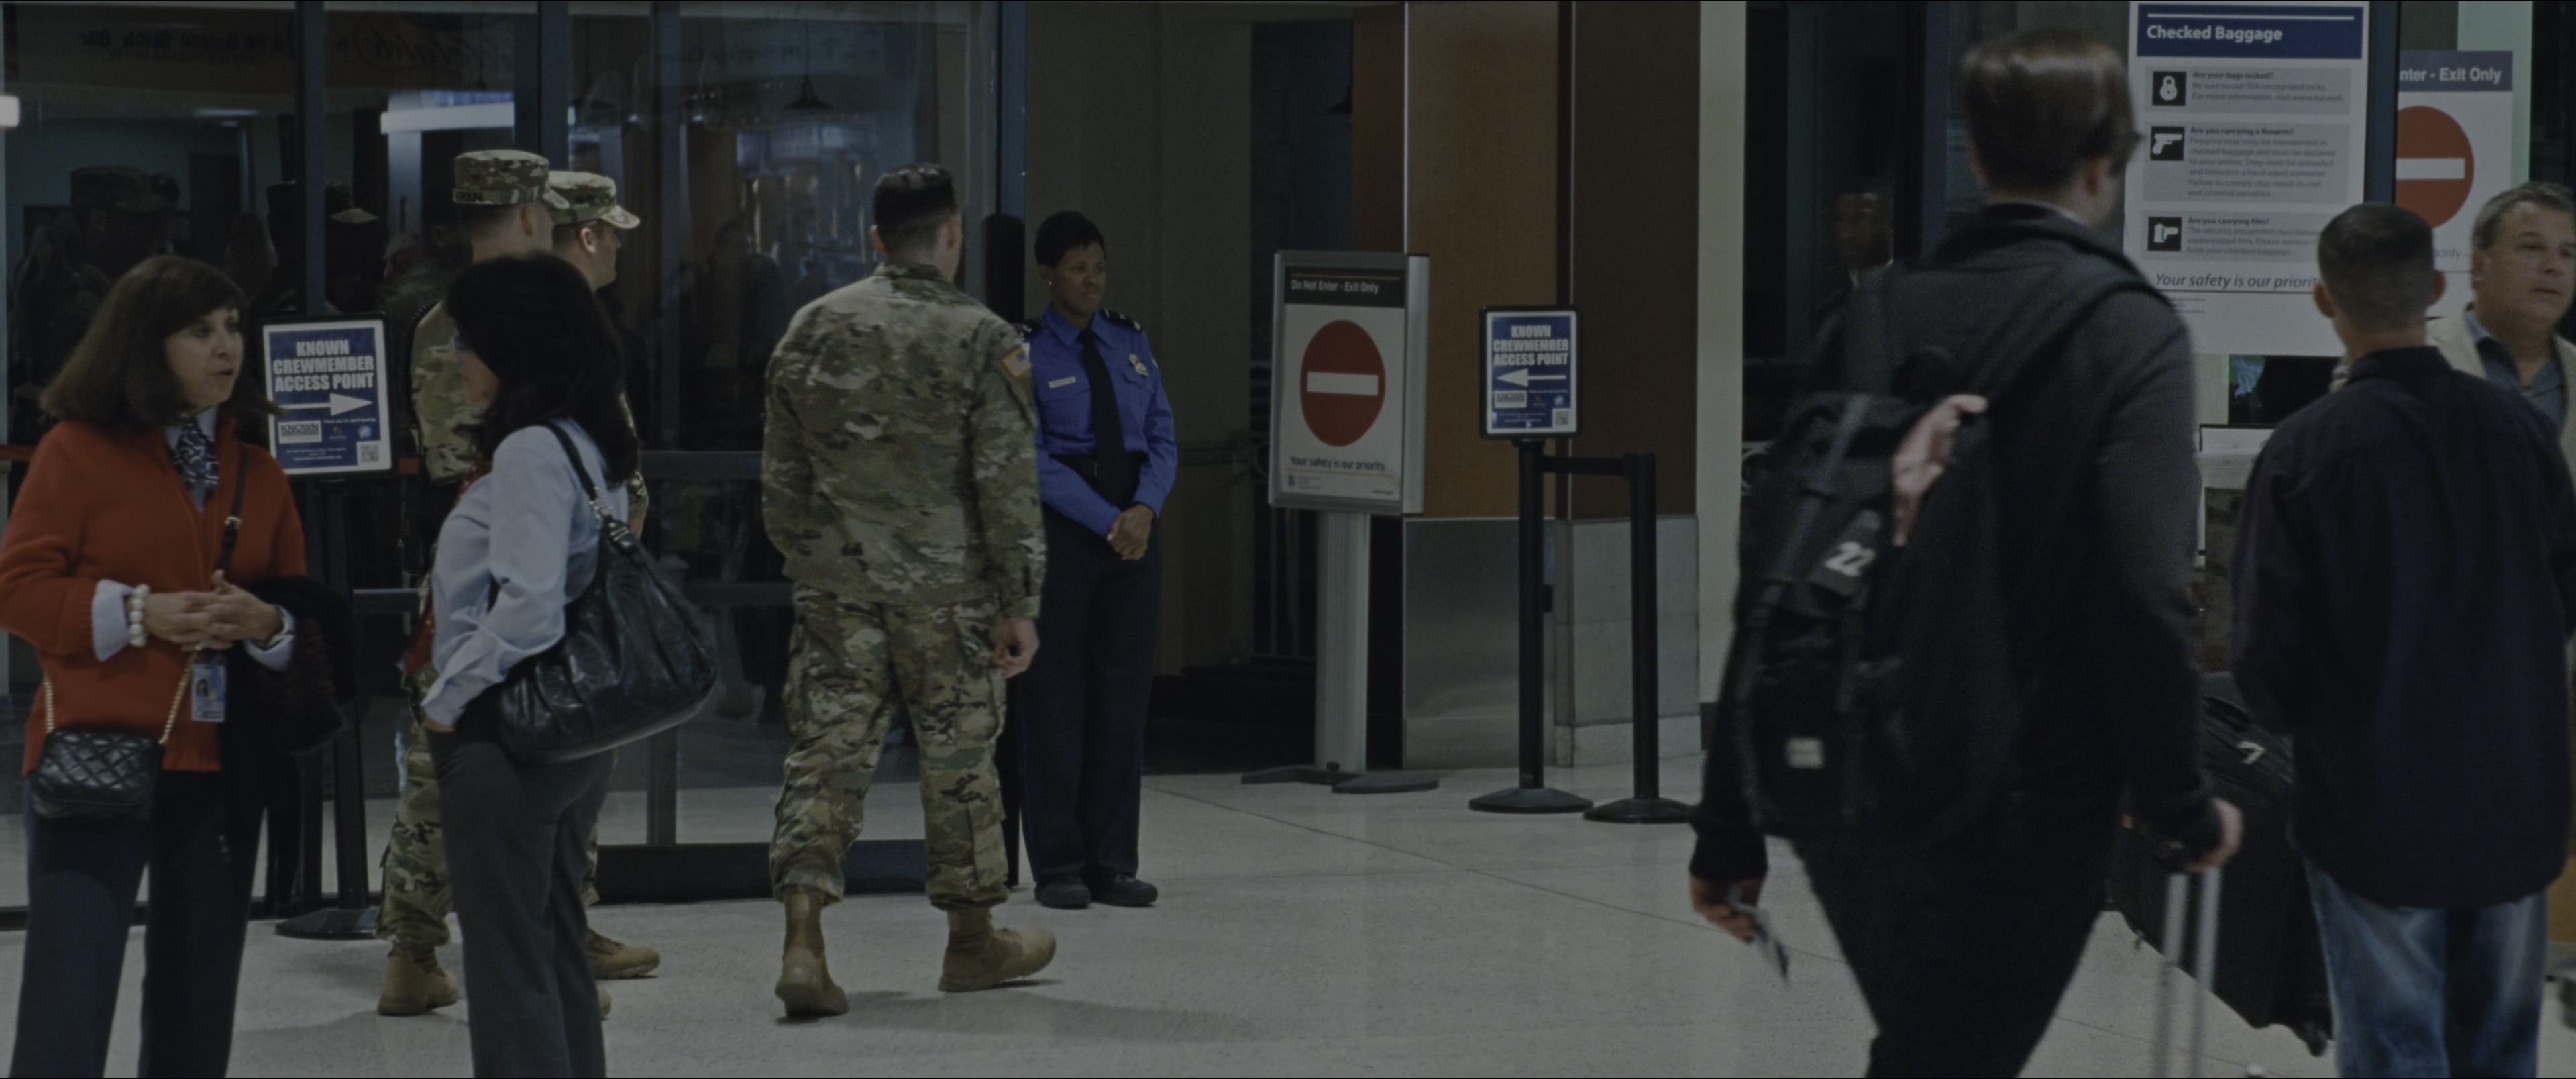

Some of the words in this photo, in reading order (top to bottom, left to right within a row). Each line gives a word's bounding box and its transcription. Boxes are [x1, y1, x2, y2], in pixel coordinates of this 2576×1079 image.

[2147, 24, 2212, 39] Checked
[2215, 25, 2283, 44] Baggage
[2226, 72, 2244, 81] bags
[2400, 68, 2427, 81] nter
[2439, 67, 2467, 82] Exit
[2469, 66, 2502, 85] Only
[2190, 126, 2204, 134] Are
[2221, 128, 2253, 136] carrying
[2261, 127, 2294, 136] firearm?
[2218, 219, 2249, 227] carrying
[1291, 280, 1301, 290] Do
[1303, 280, 1317, 291] Not
[1318, 280, 1338, 291] Enter
[1344, 282, 1359, 292] Exit
[1360, 282, 1379, 295] Only
[2156, 274, 2186, 286] Your
[2189, 274, 2231, 289] safety
[2233, 274, 2244, 287] is
[2246, 276, 2272, 287] our
[1511, 325, 1551, 338] KNOWN
[295, 339, 350, 357] KNOWN
[1493, 339, 1570, 352] CREWMEMBER
[272, 355, 375, 375] CREWMEMBER
[1493, 353, 1536, 366] ACCESS
[1536, 352, 1568, 366] POINT
[274, 374, 331, 392] ACCESS
[332, 372, 375, 389] POINT
[281, 423, 320, 433] KNOWN
[1290, 456, 1307, 466] Your
[1309, 457, 1332, 470] safety
[1334, 460, 1340, 468] is
[1341, 460, 1354, 469] our
[1355, 460, 1386, 473] priority
